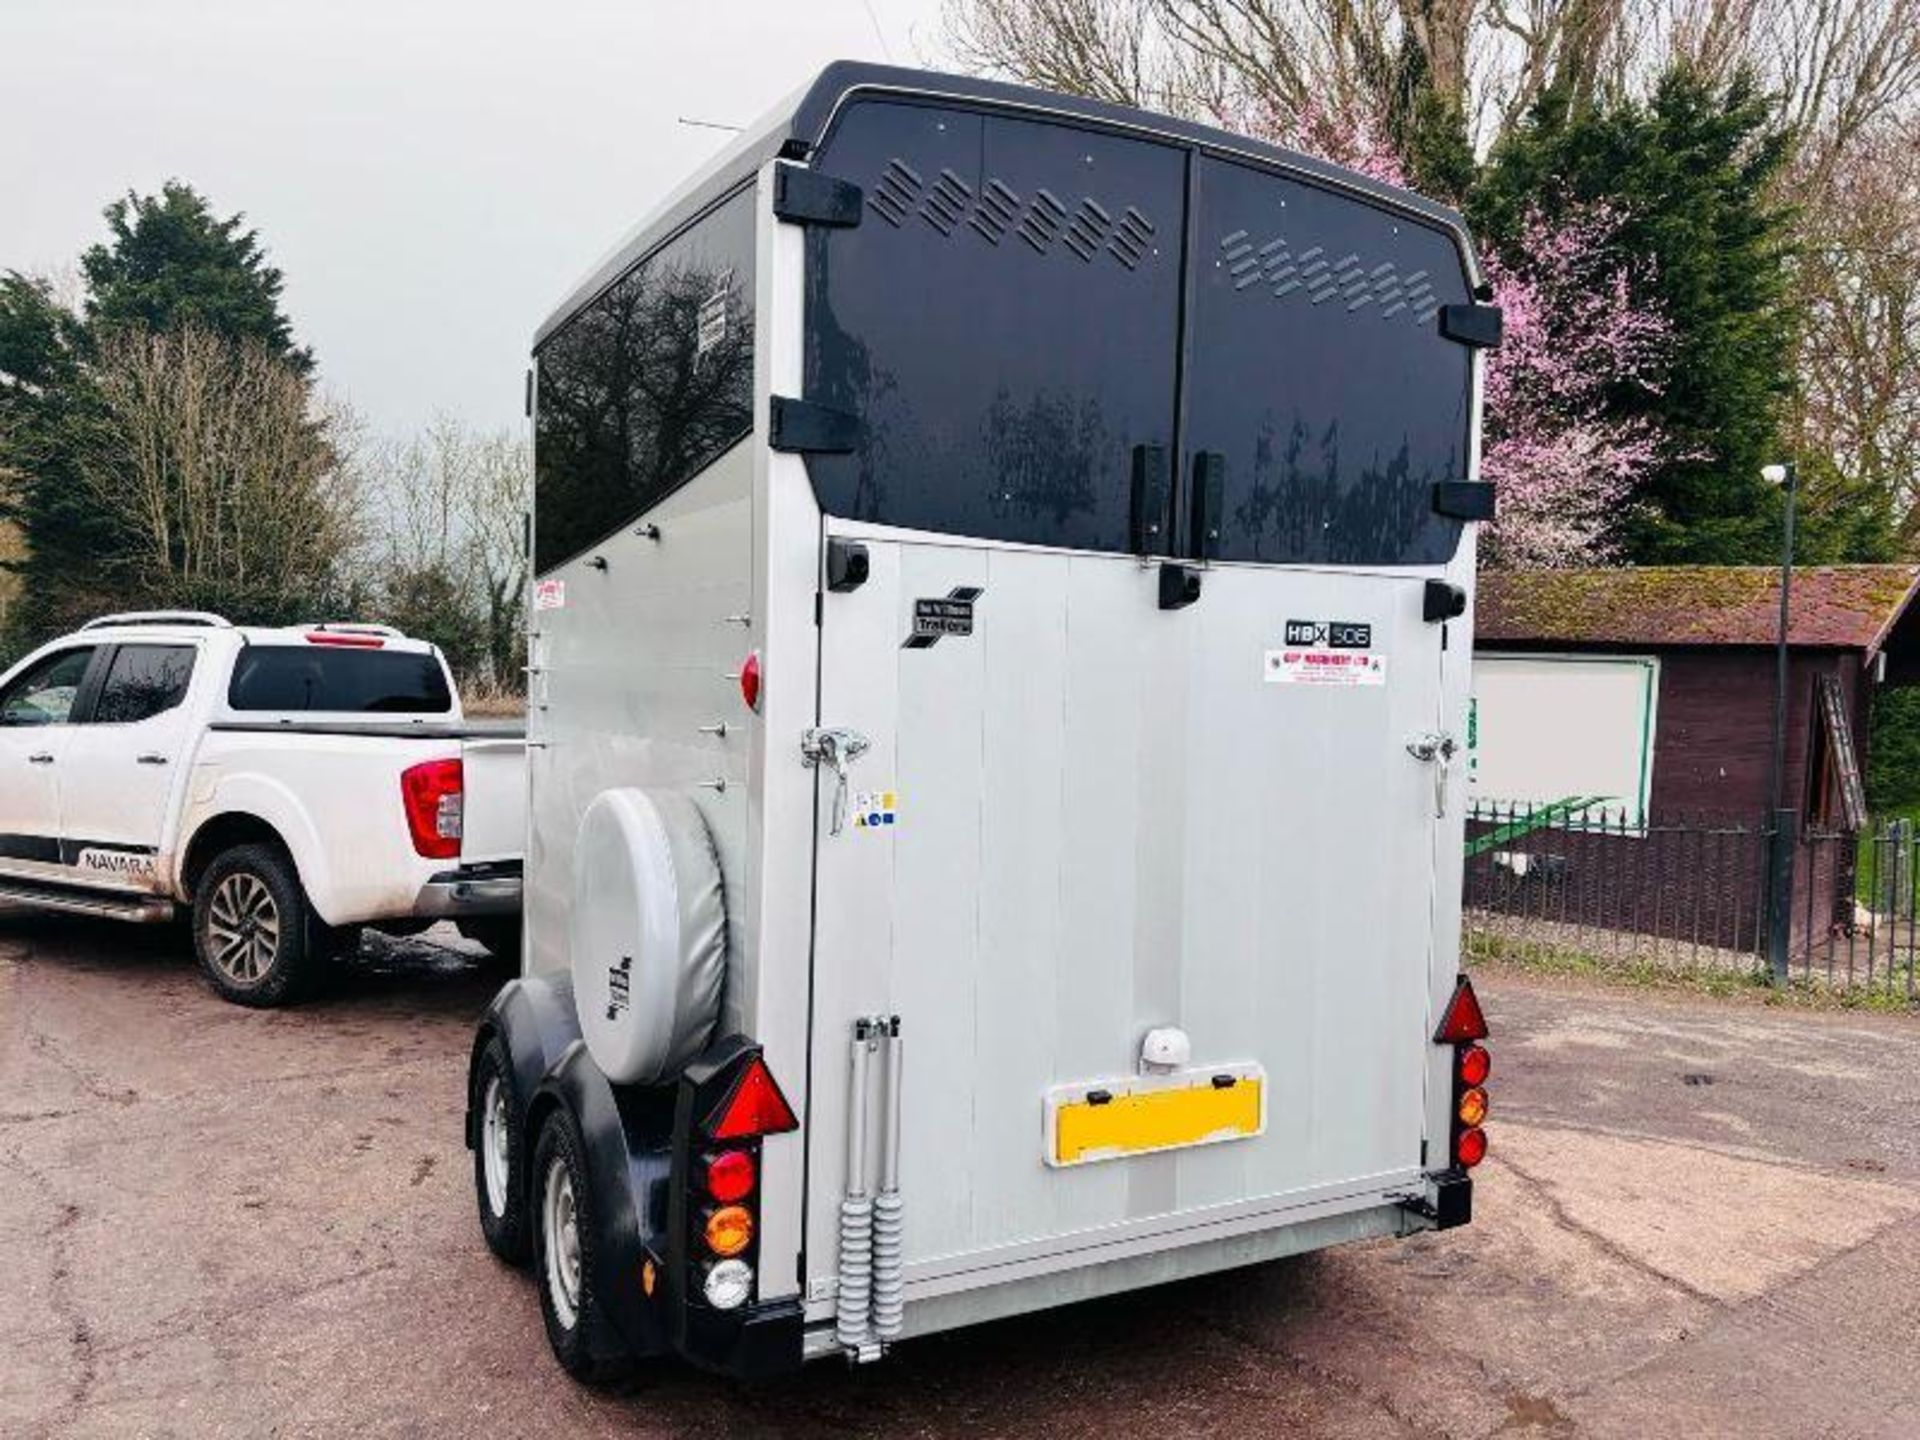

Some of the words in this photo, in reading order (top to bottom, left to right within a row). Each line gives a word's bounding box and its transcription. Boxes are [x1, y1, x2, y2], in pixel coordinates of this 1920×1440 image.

[1287, 623, 1329, 643] HBX
[1332, 627, 1369, 645] 506
[85, 854, 154, 875] NAVARA
